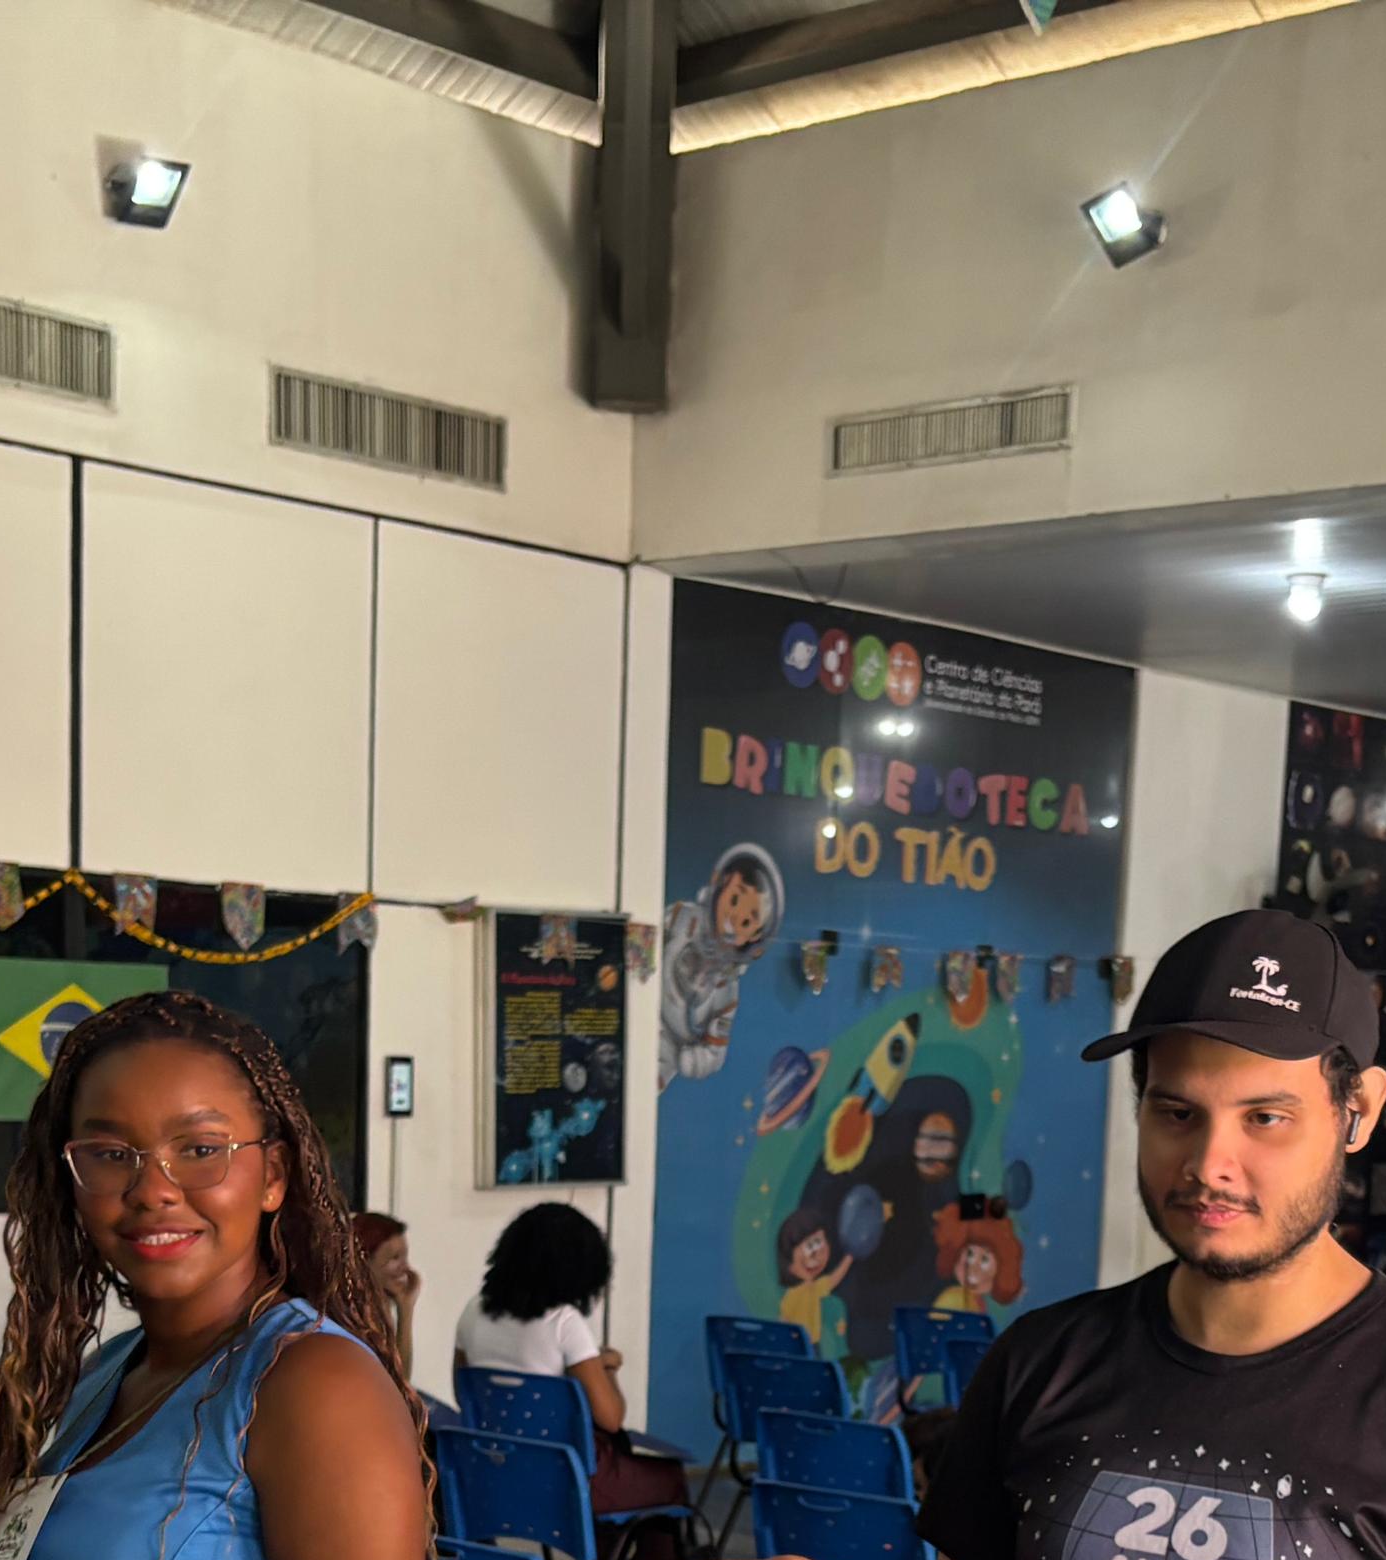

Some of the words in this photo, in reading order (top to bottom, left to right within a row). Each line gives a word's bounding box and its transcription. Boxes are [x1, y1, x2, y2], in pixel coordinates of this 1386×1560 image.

[700, 726, 1091, 836] BRINQUEDOTECA
[816, 817, 882, 878] DO
[894, 824, 997, 892] TIÃO
